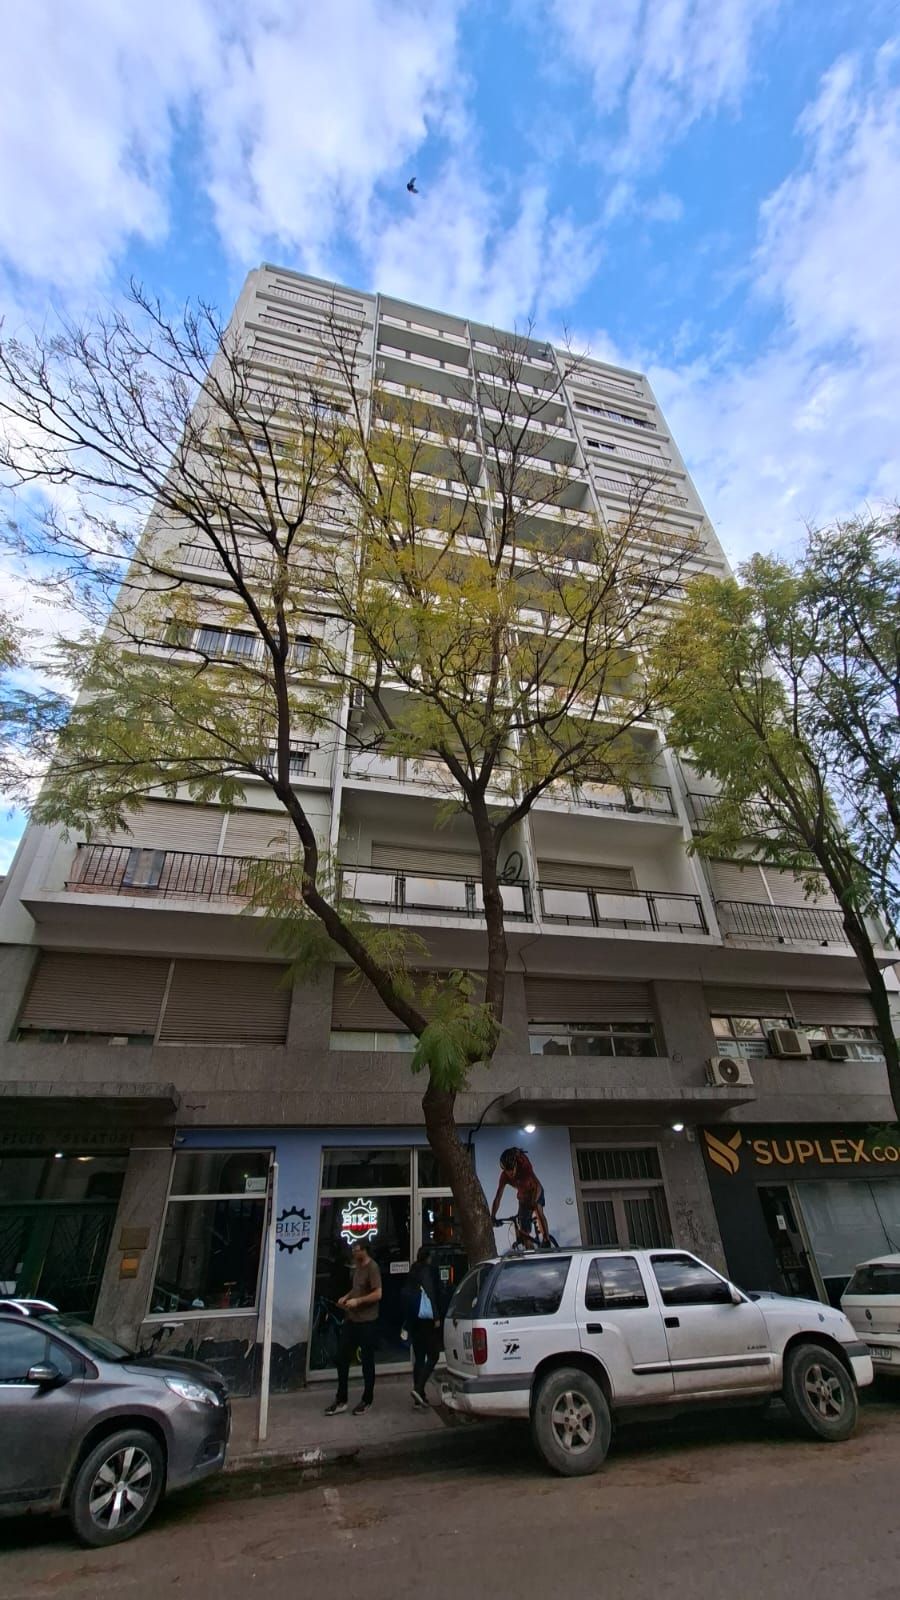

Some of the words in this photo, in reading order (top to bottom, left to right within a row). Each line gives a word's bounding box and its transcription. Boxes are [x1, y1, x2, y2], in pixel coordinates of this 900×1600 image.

[753, 1139, 870, 1164] SUPLEX
[342, 1213, 378, 1226] BIKE
[276, 1221, 310, 1233] BIKE
